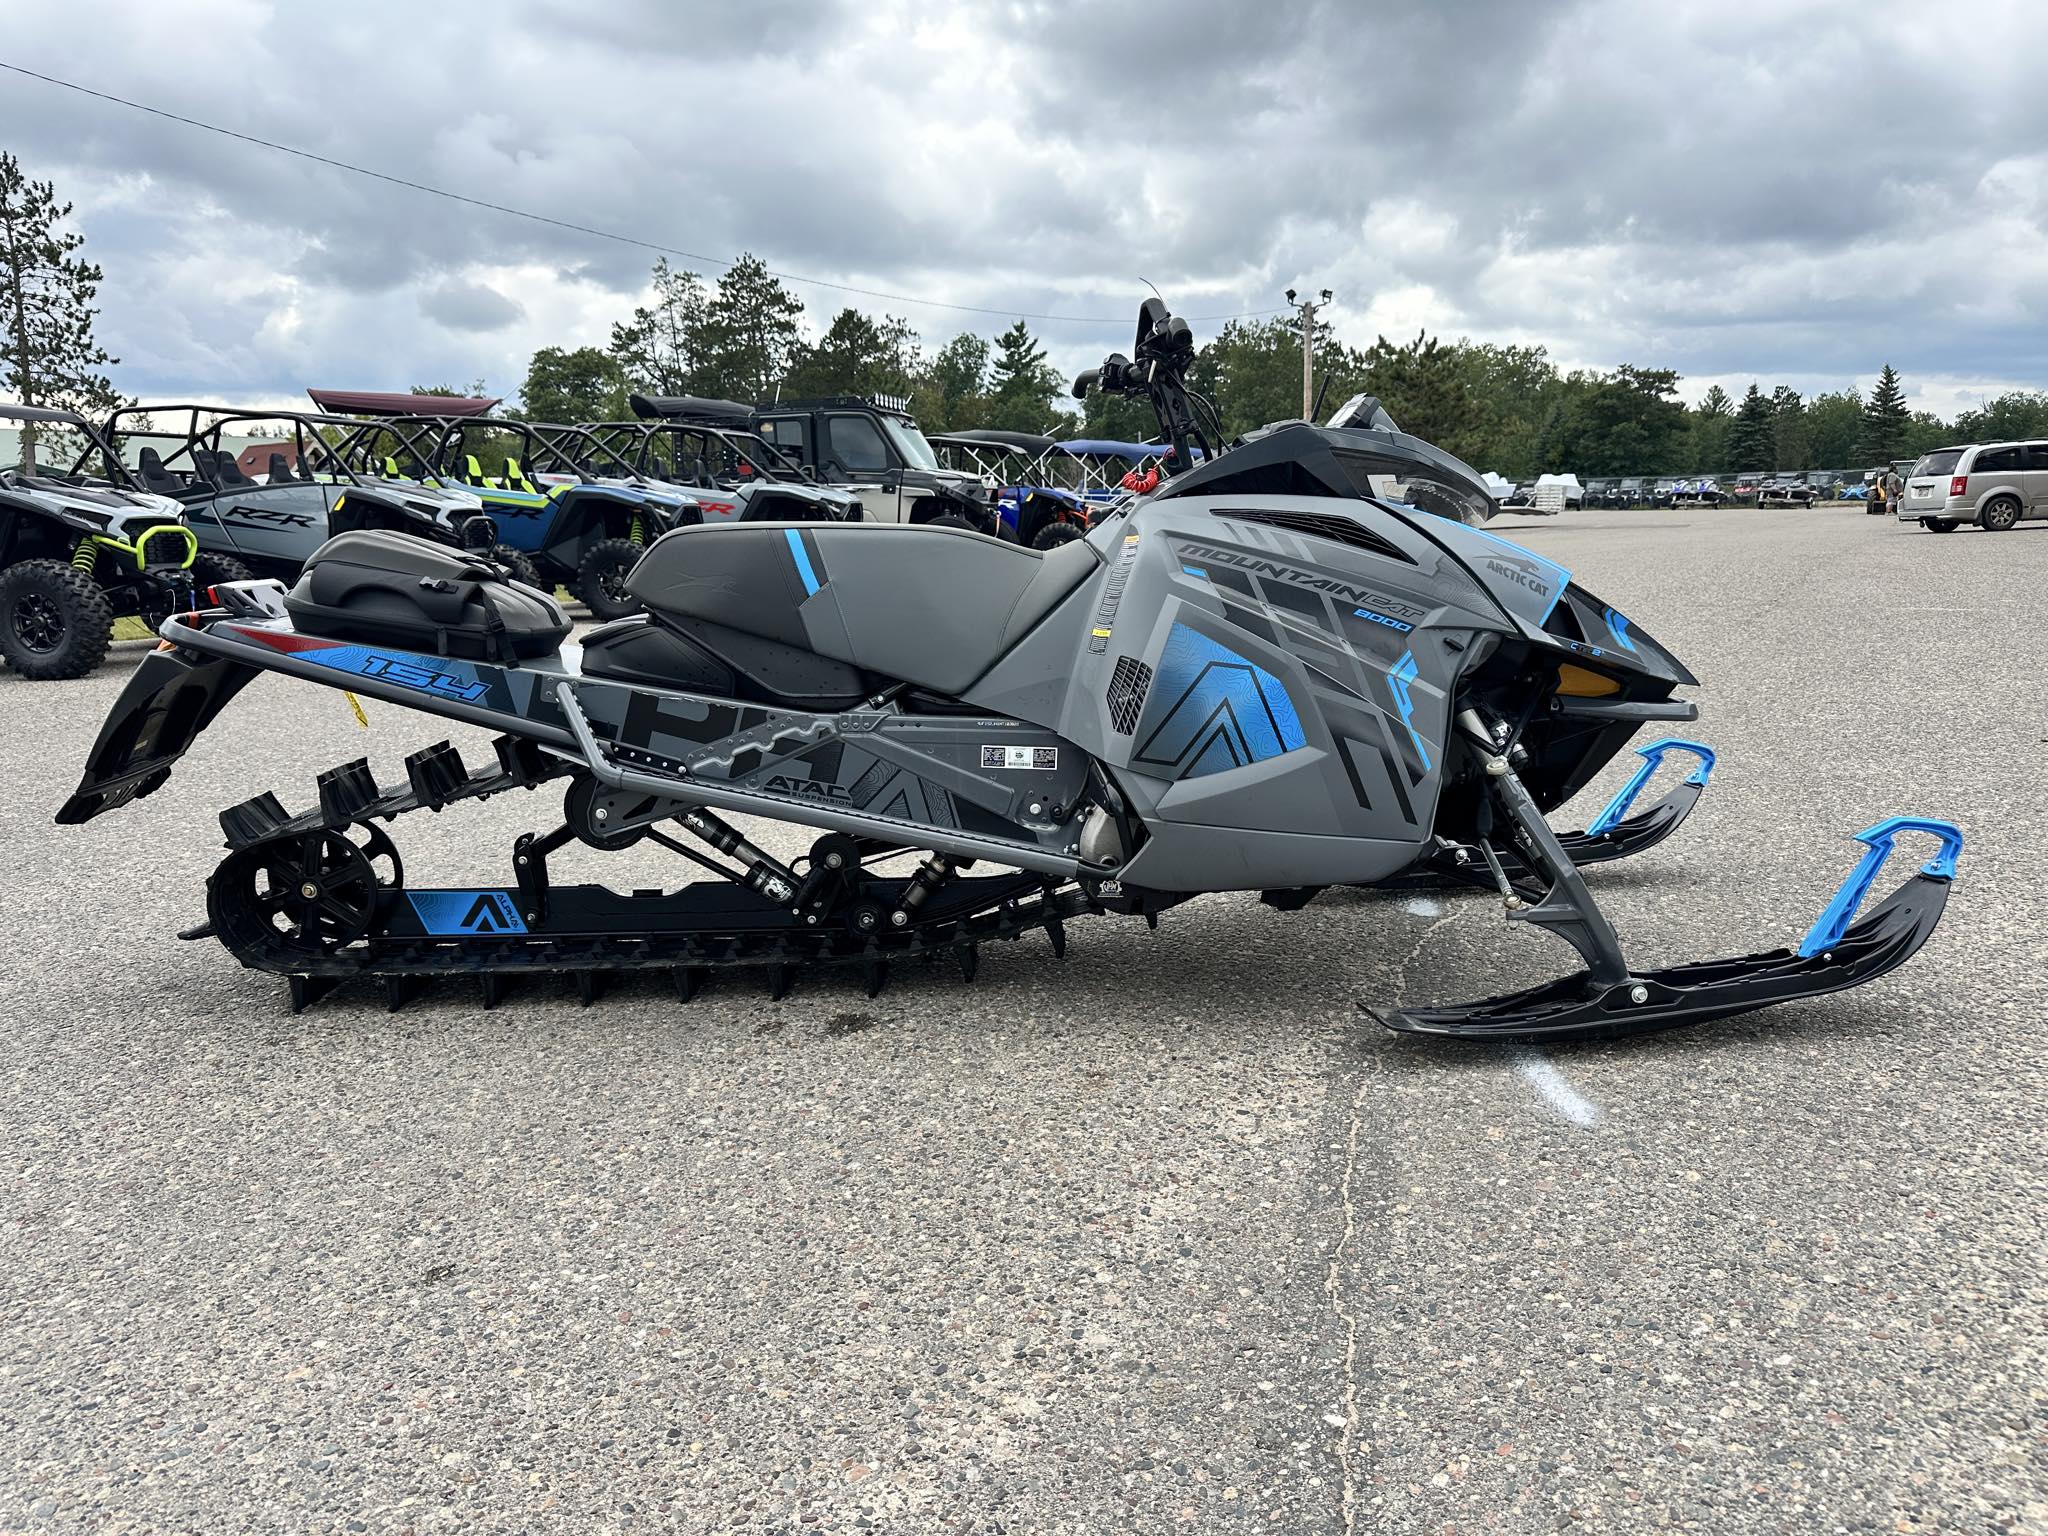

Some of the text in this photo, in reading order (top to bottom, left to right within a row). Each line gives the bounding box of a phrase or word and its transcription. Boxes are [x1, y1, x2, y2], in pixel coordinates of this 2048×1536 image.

[225, 505, 317, 529] RZR
[1486, 559, 1550, 598] ARCTIC CAT
[1352, 608, 1413, 633] 8000
[360, 655, 493, 702] 154
[764, 774, 852, 801] ATAC
[791, 790, 853, 808] SUSPENSION
[496, 894, 520, 929] ALPHA
